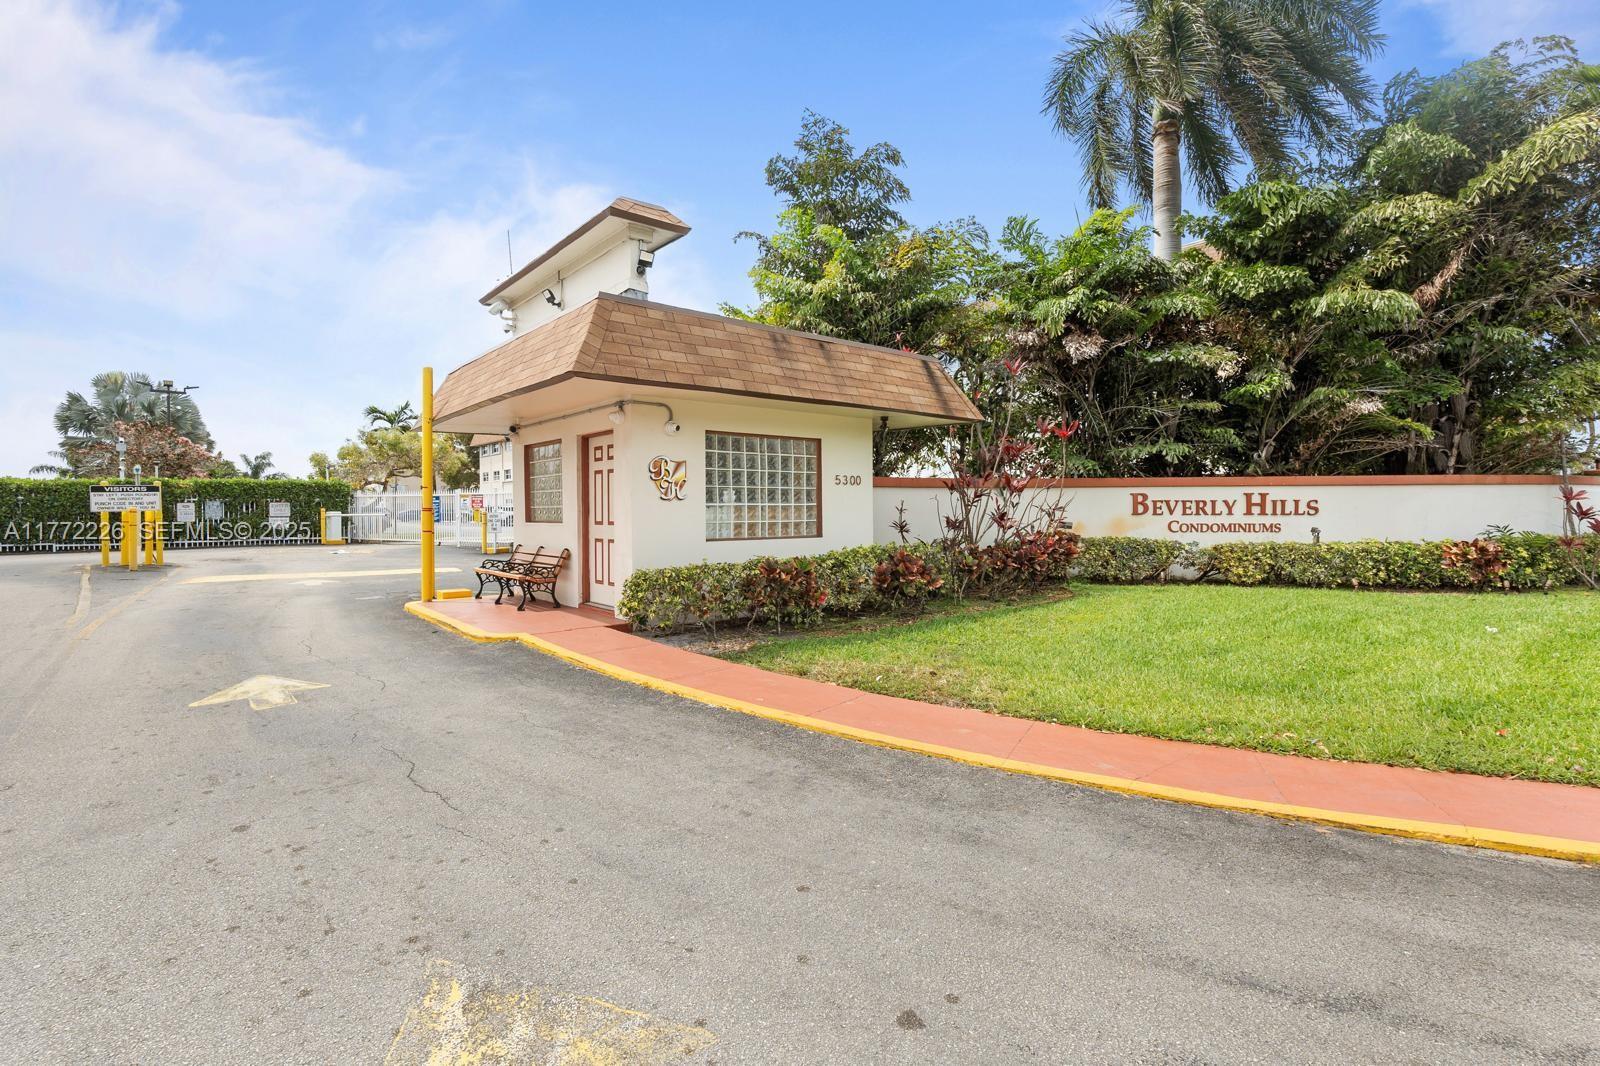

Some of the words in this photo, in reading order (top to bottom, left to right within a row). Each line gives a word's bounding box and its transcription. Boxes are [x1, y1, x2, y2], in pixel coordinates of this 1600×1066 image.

[834, 474, 862, 486] 5300
[1129, 492, 1238, 516] BEVERLY
[1243, 492, 1320, 516] HILLS
[1167, 520, 1282, 533] CONDOMINIUMS
